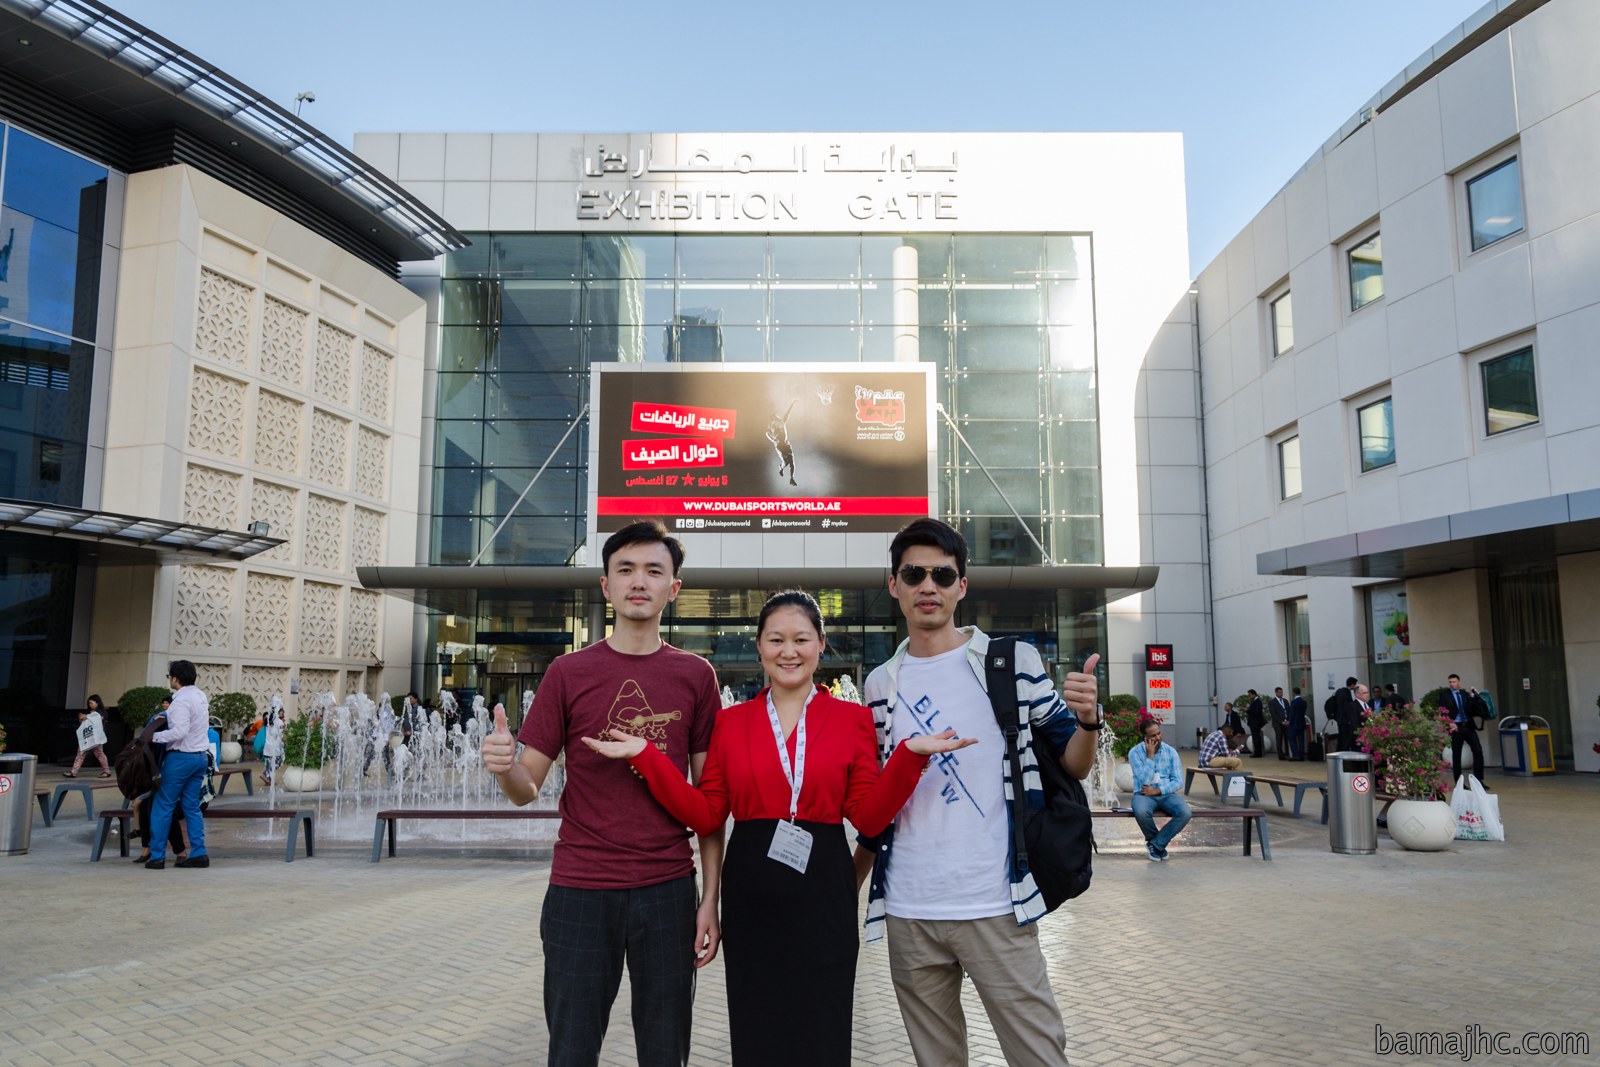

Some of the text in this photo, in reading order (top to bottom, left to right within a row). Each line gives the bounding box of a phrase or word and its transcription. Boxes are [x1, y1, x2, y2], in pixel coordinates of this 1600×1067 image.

[576, 190, 959, 220] EXHIBITION GATE
[639, 410, 730, 432] جميع الرياضات
[631, 443, 719, 464] طوال الصيف
[665, 475, 679, 486] 27
[697, 475, 720, 487] يوليو
[683, 502, 841, 511] WWW.DUBAISPORTSWORLD.AE
[1152, 653, 1168, 661] ibis
